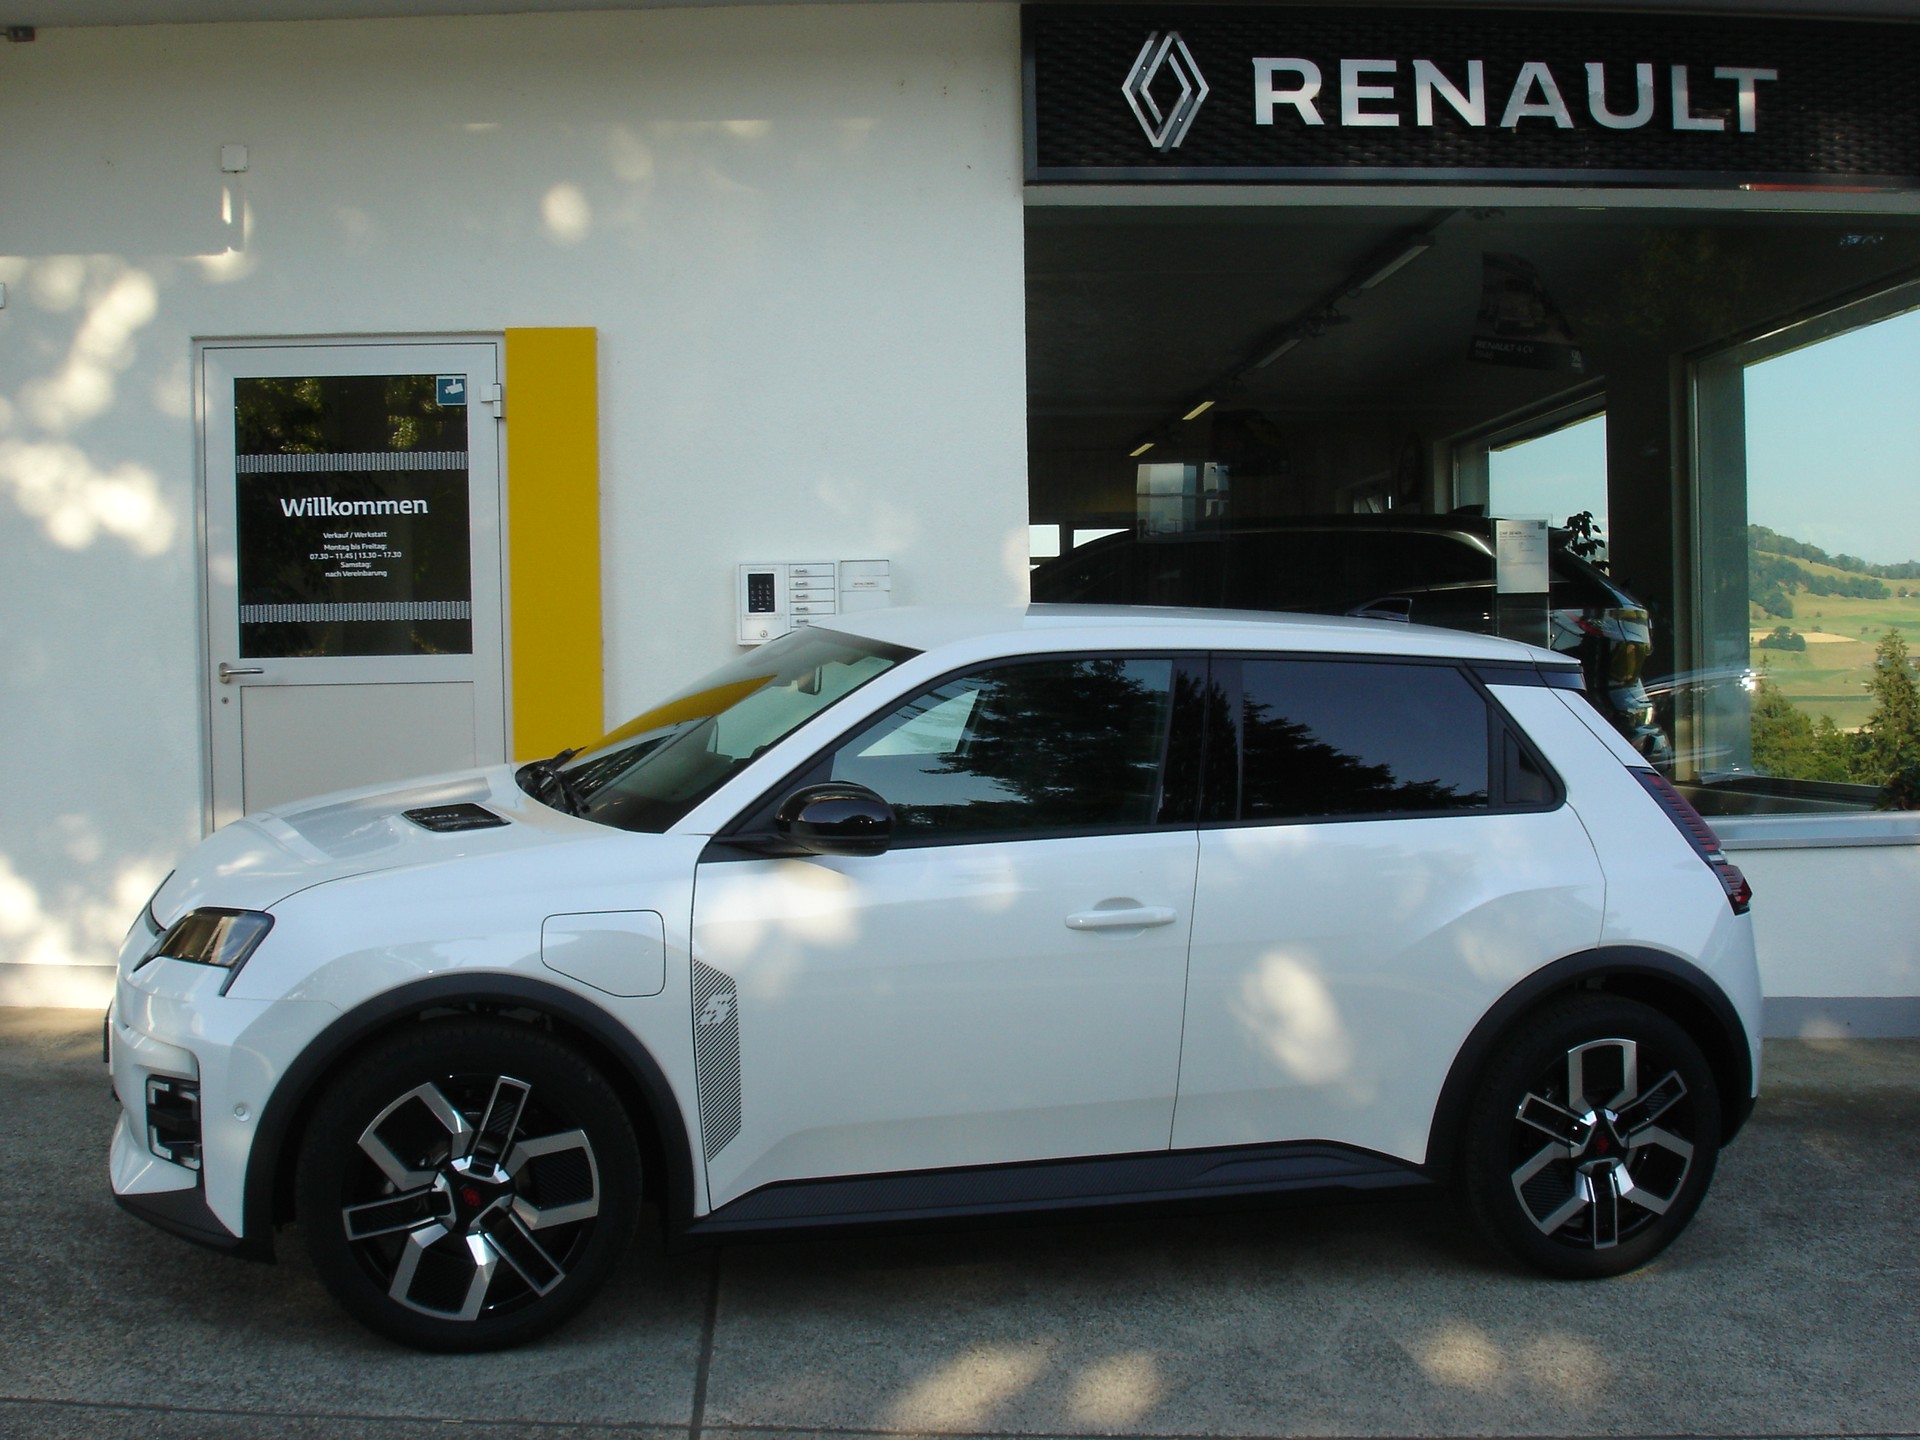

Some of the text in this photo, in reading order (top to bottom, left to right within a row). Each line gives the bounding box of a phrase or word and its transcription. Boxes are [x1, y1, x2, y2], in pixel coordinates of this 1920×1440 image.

[1252, 57, 1779, 135] RENAULT
[280, 496, 429, 517] Willkommen
[323, 532, 349, 540] Verkauf
[354, 531, 388, 539] Werkstatt
[323, 542, 388, 552] Montag bis Freitag:
[340, 561, 372, 569] Samstag:
[342, 569, 388, 577] Vereinbarung
